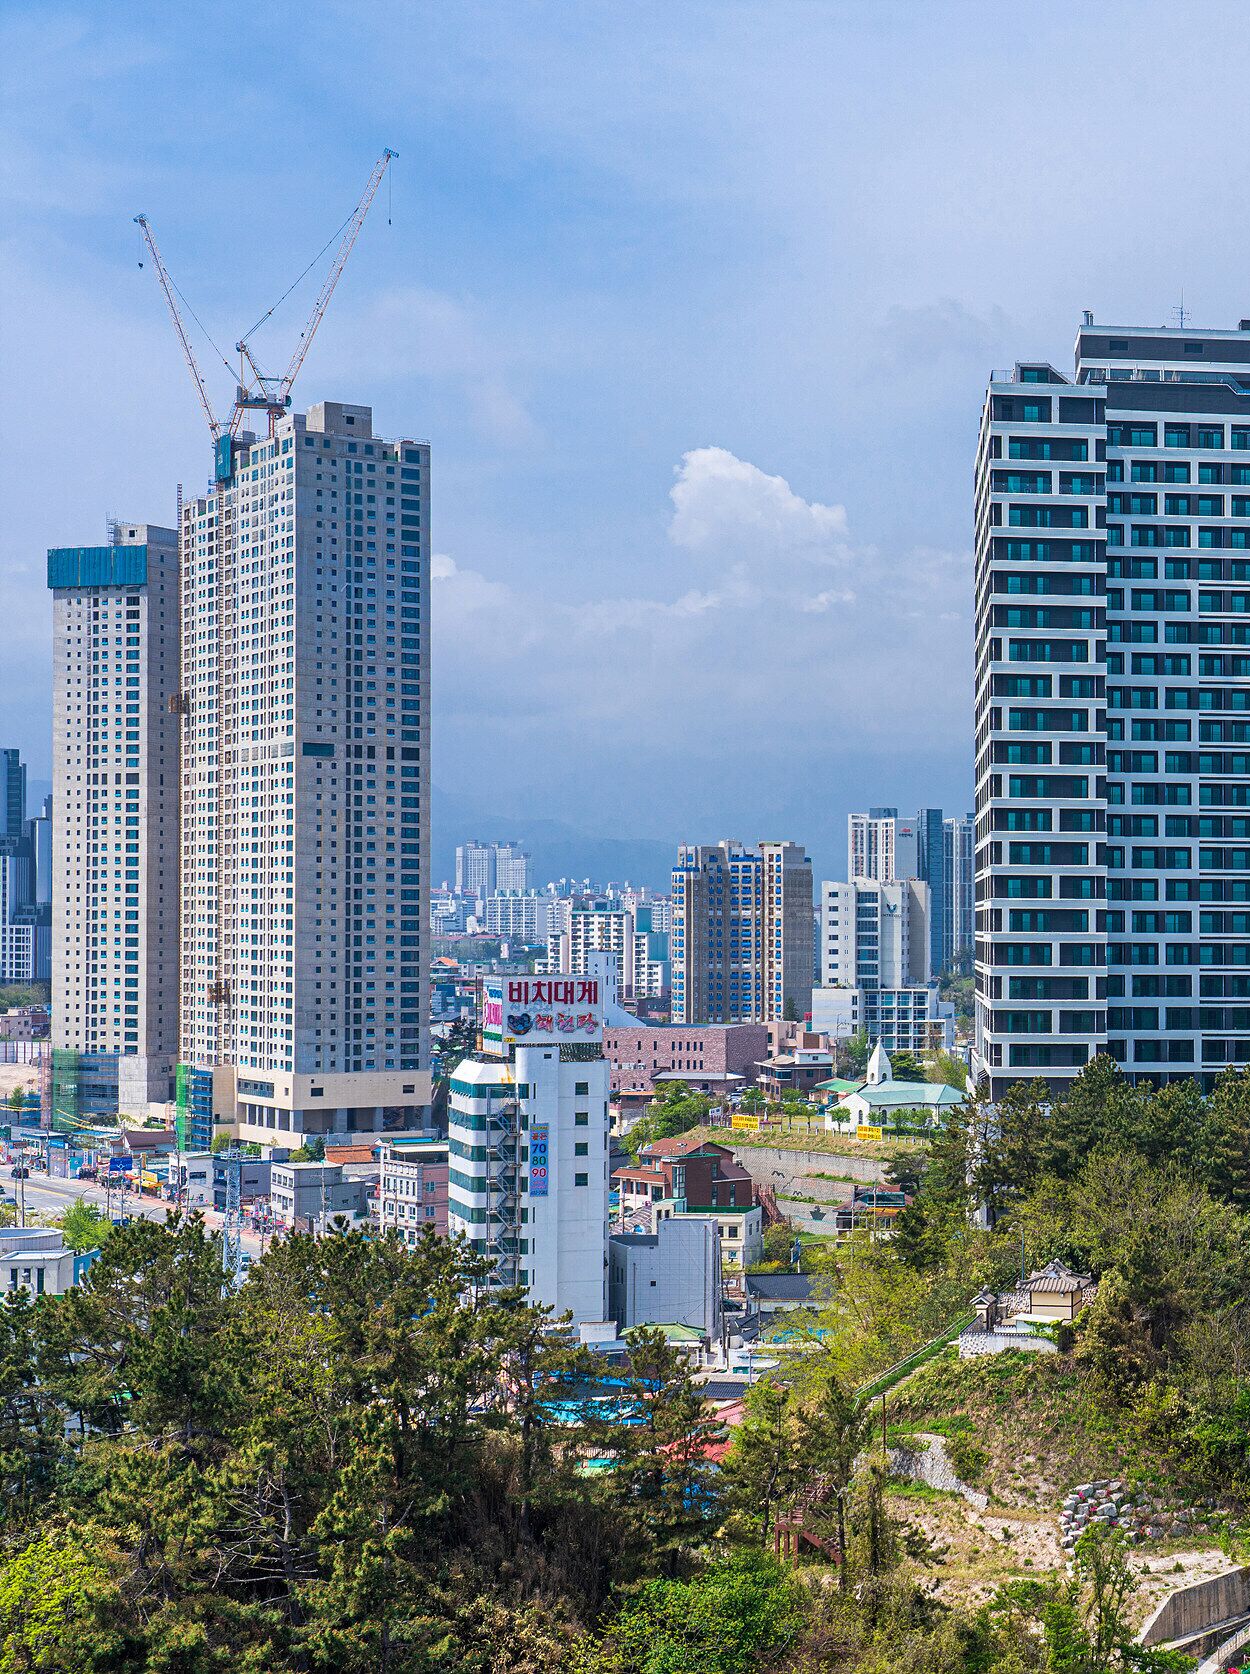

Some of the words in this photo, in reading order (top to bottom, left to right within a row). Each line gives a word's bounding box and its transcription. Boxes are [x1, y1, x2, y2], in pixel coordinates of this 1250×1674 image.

[508, 980, 598, 1004] 비치대게
[532, 1144, 547, 1153] 70
[532, 1156, 547, 1166] 80
[532, 1168, 547, 1178] 90
